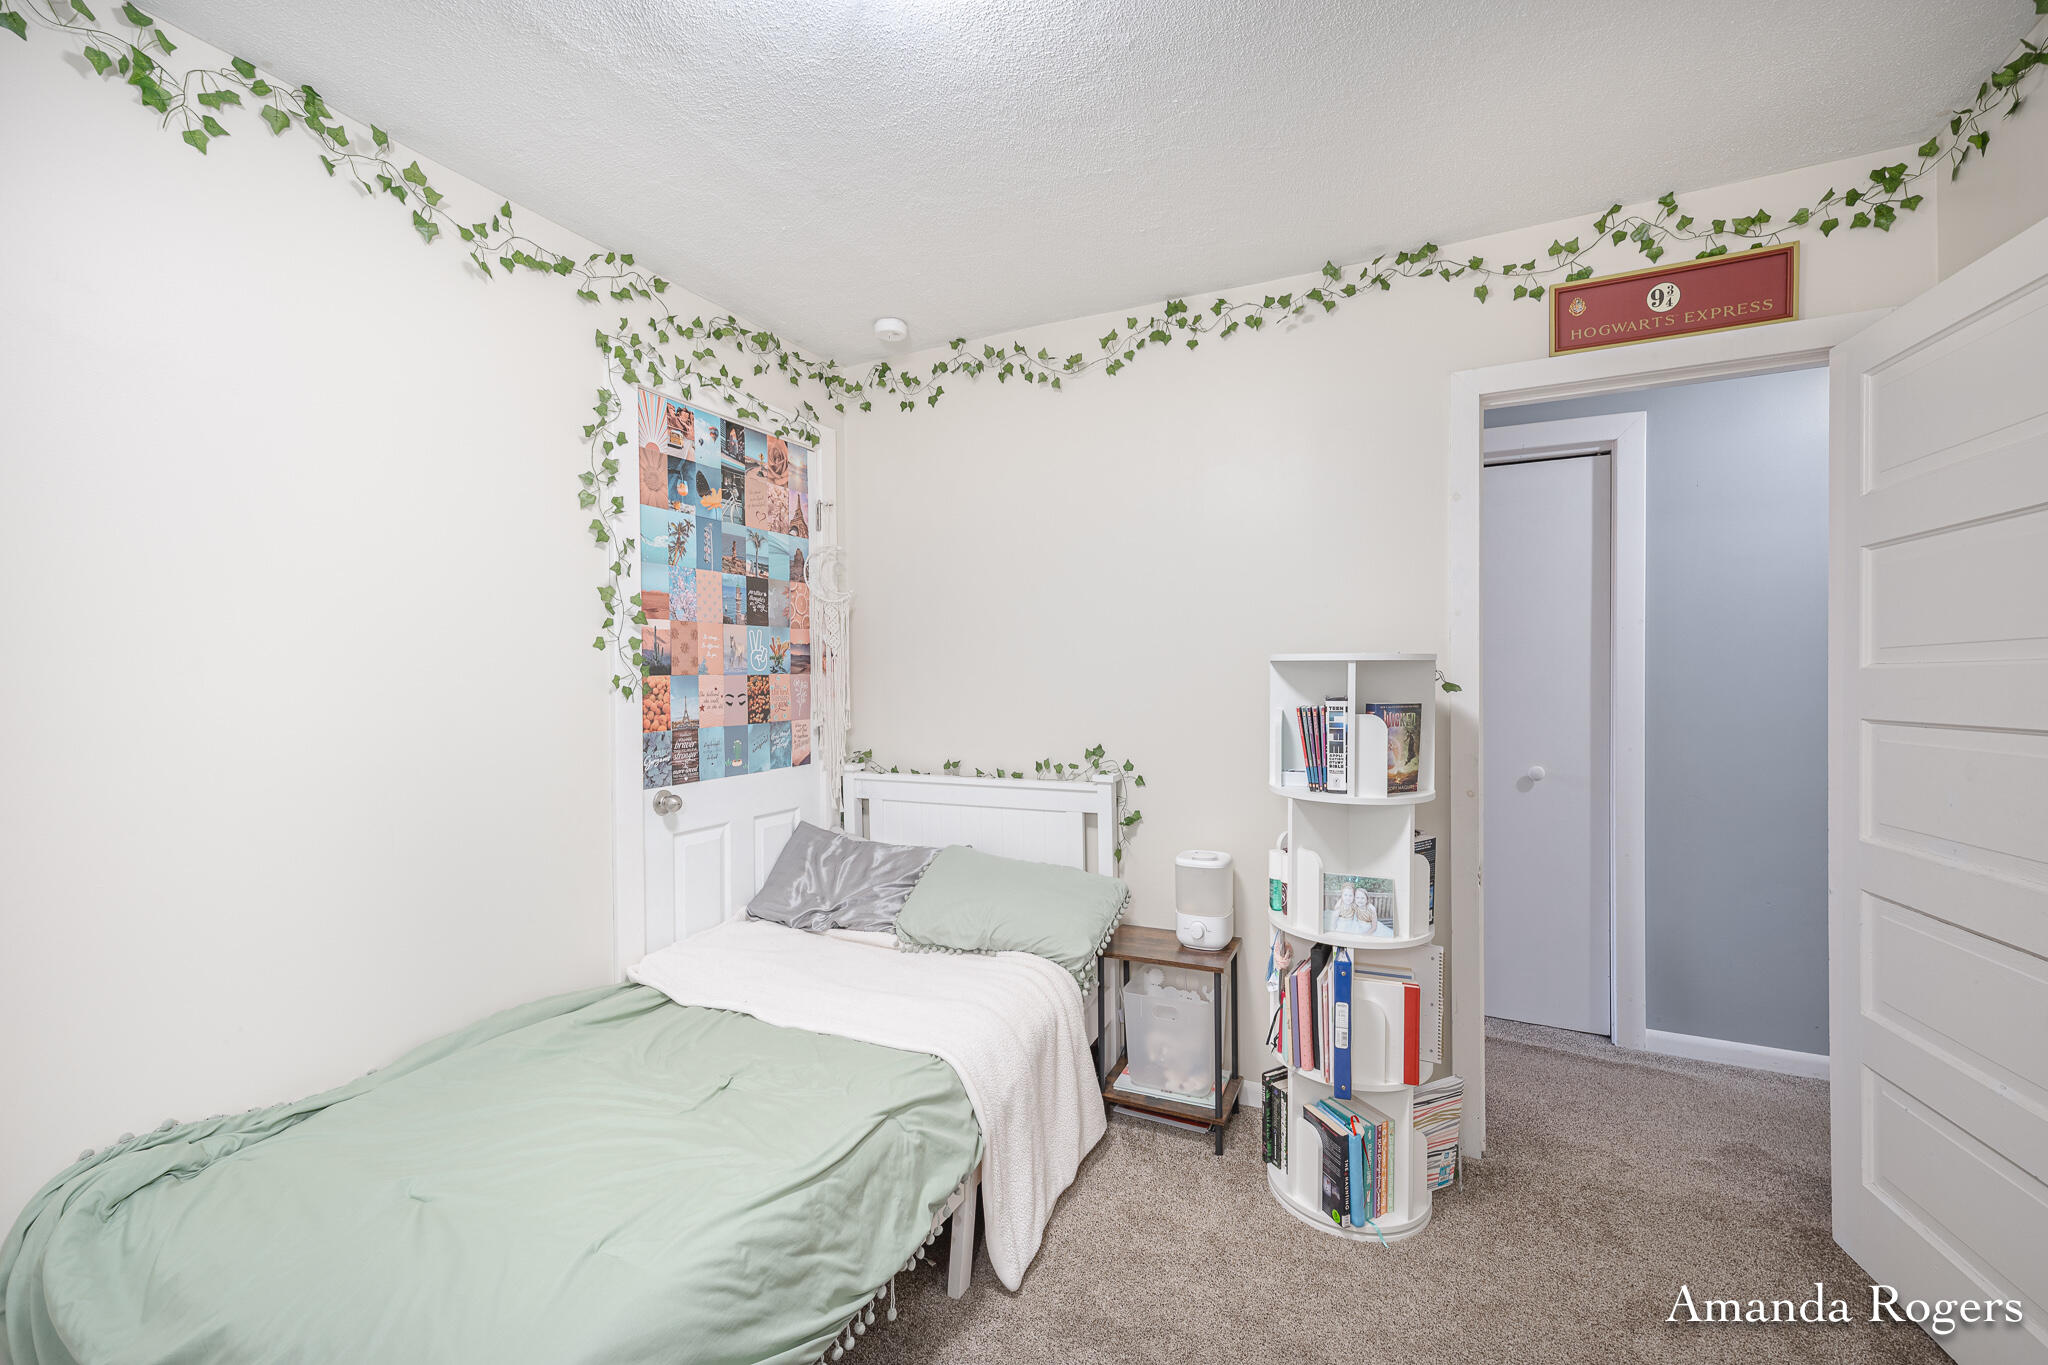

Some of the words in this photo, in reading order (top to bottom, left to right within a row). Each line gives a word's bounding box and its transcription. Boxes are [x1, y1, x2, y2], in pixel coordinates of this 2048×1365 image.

[1571, 315, 1675, 340] HOGWARTS
[1685, 299, 1774, 323] EXPRESS
[1329, 711, 1344, 754] LIFE
[1383, 710, 1416, 728] WICKED
